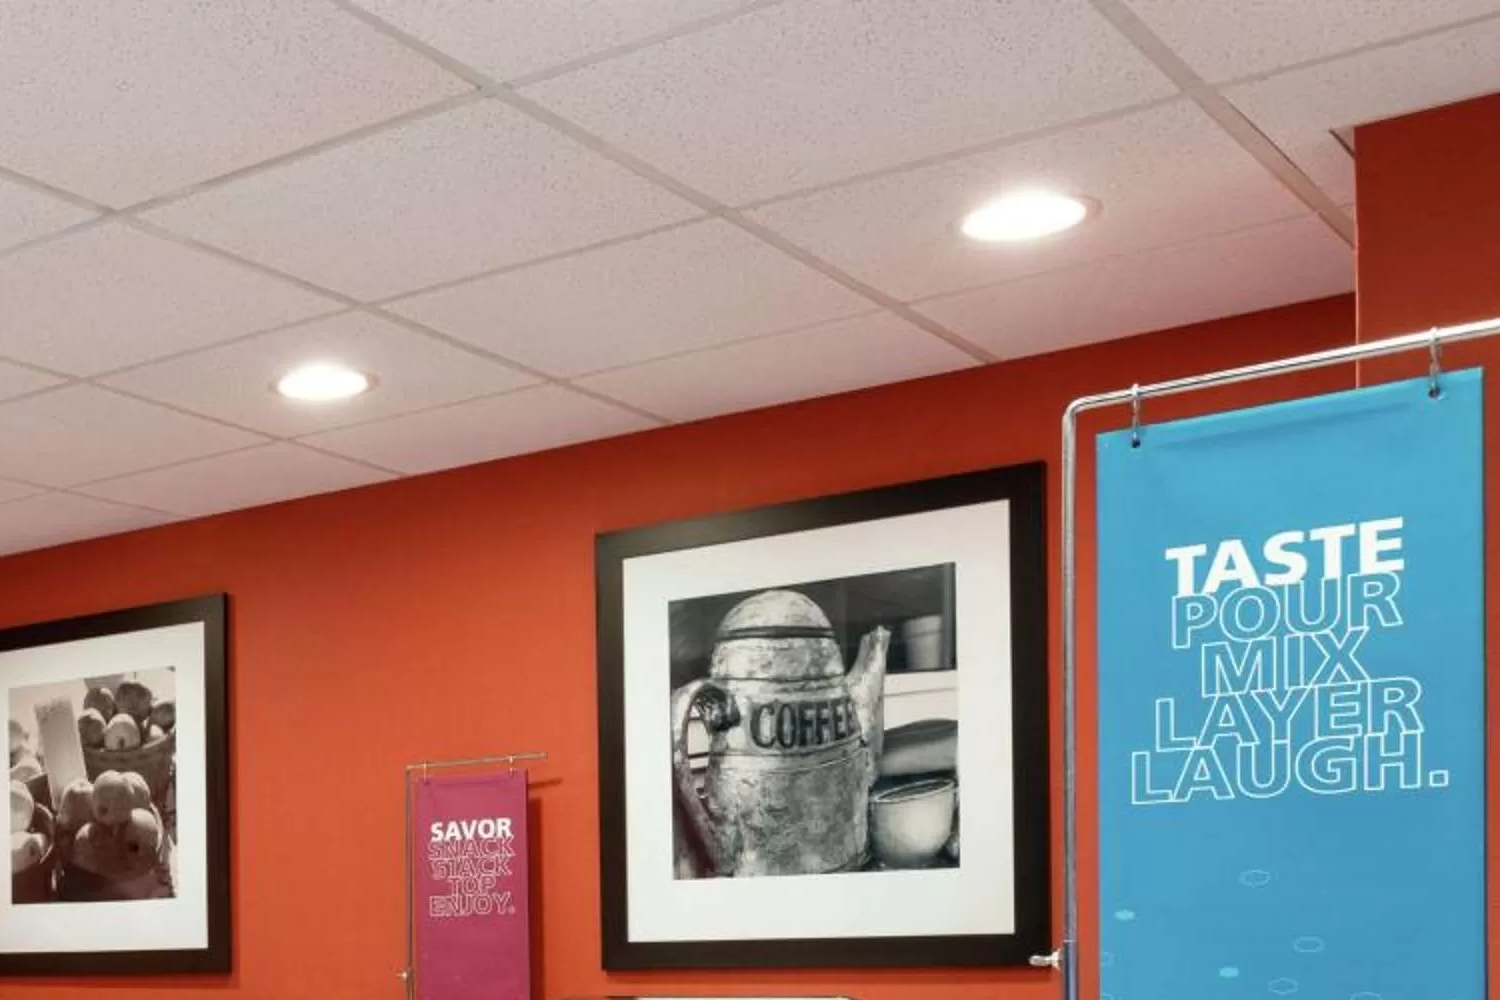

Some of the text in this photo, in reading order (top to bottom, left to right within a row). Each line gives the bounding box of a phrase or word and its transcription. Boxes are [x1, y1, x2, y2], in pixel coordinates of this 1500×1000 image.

[1165, 517, 1405, 597] TASTE
[1172, 571, 1404, 649] POUR
[1202, 626, 1369, 698] MIX
[1156, 677, 1424, 752] LAYER
[1131, 732, 1450, 805] LAUGH.
[427, 836, 516, 860] SNACK
[430, 817, 512, 842] SAVOR
[431, 857, 513, 880] STACK
[447, 876, 497, 897] TOP
